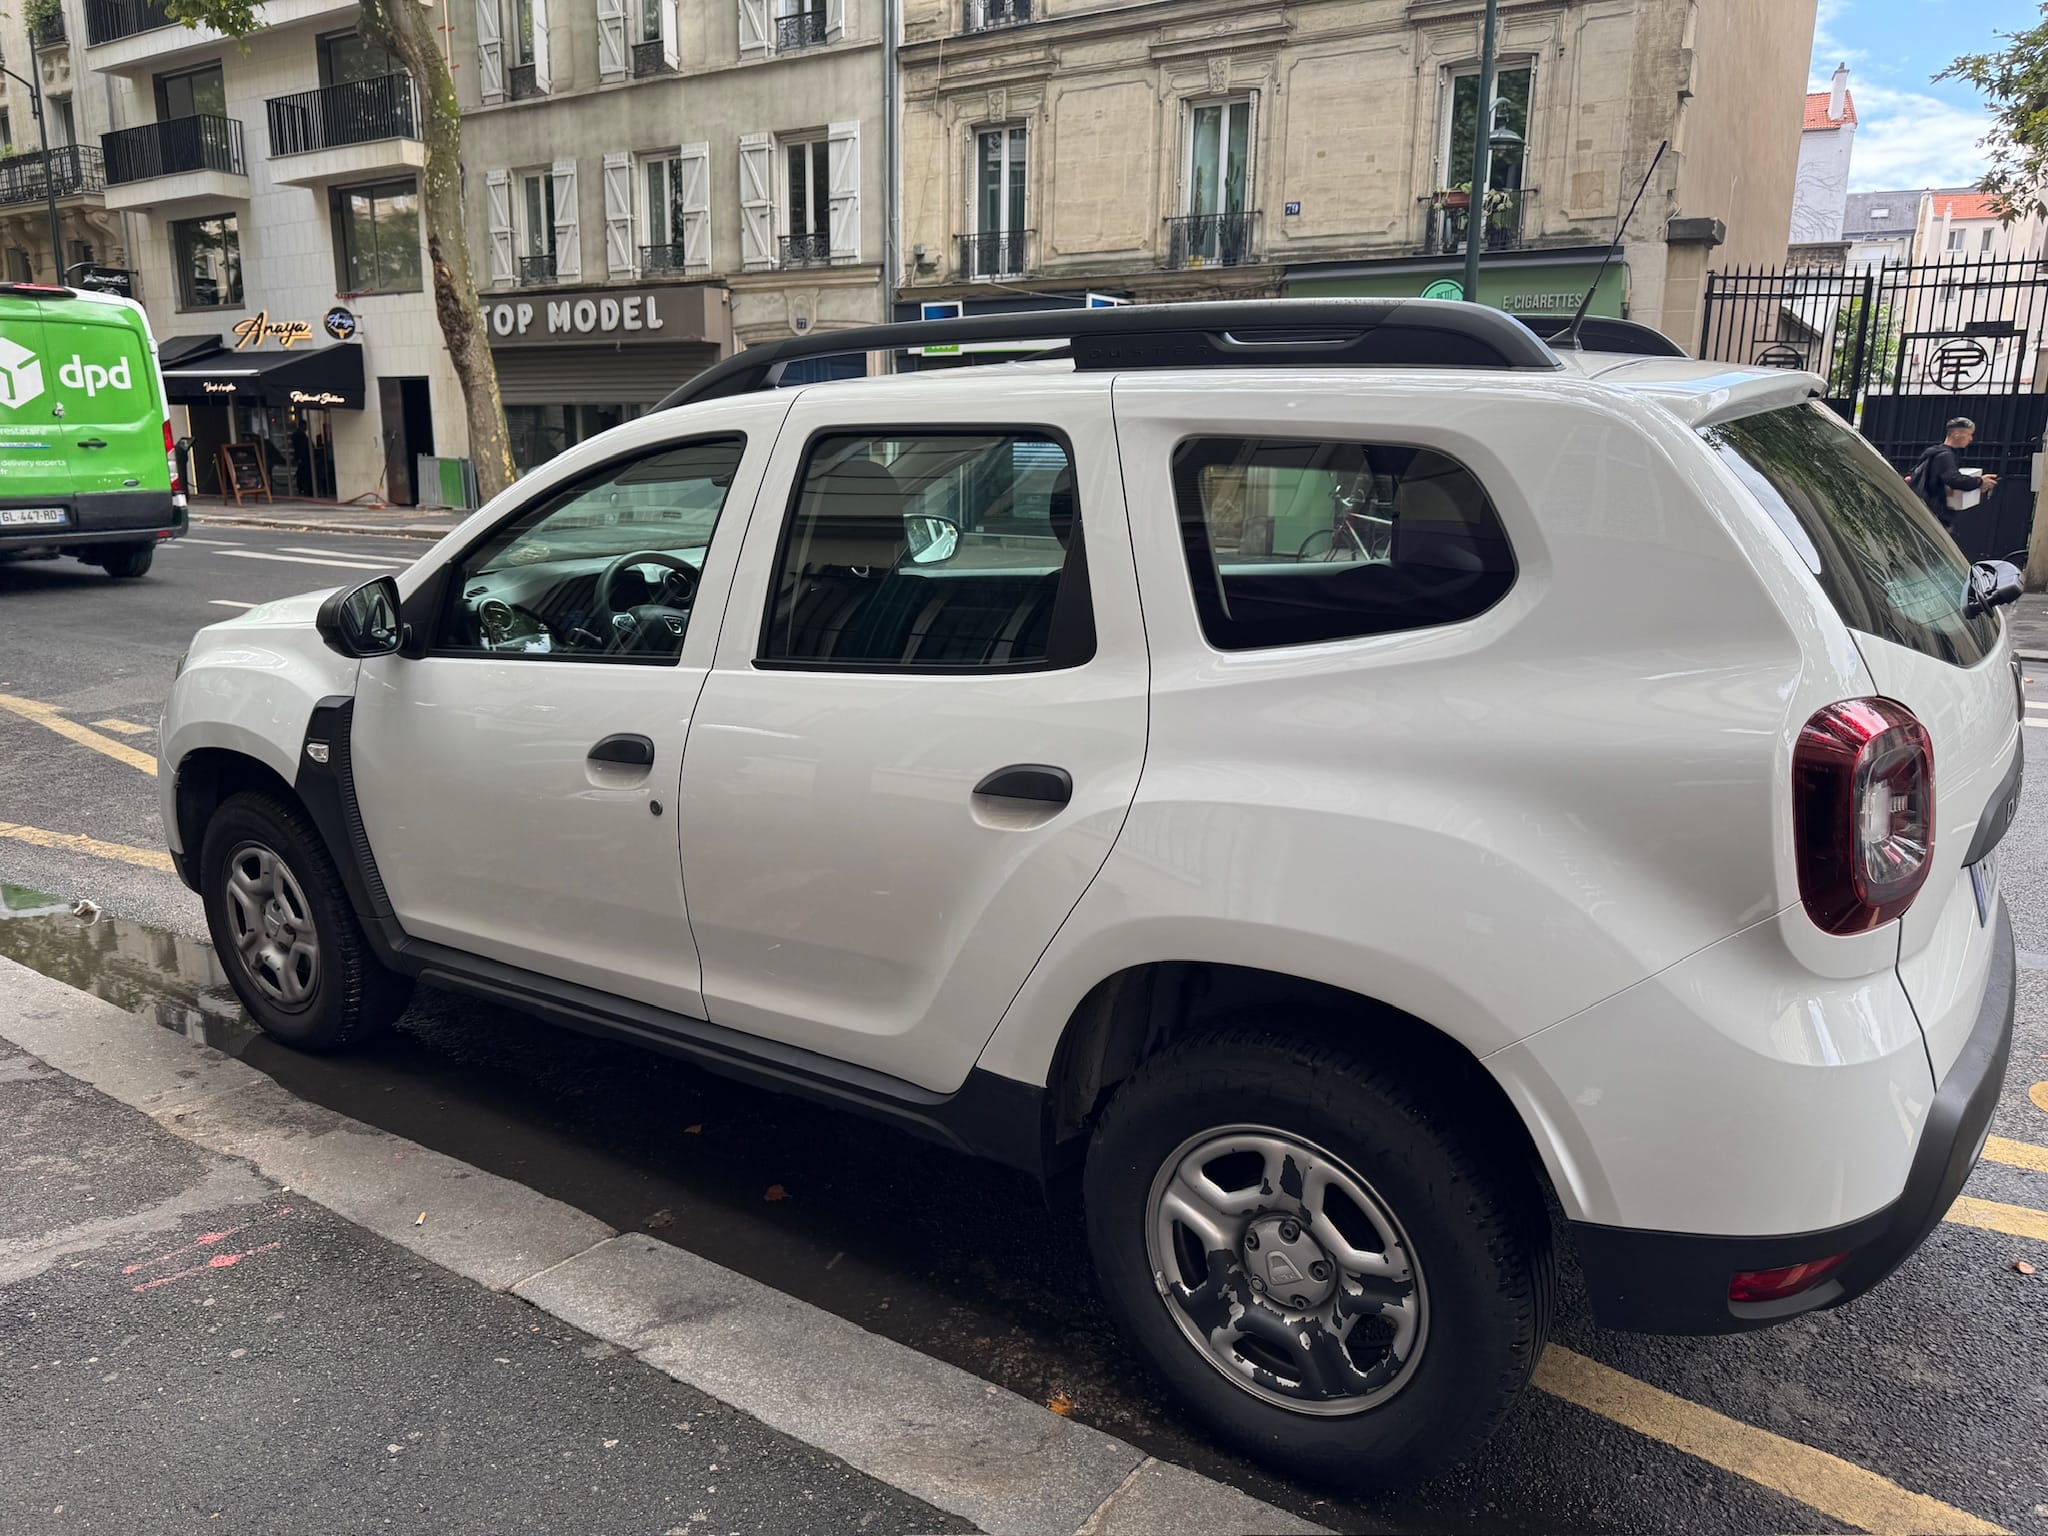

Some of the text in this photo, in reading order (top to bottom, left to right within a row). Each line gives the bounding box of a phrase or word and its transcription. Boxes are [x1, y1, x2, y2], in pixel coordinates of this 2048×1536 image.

[480, 295, 664, 336] TOP MODEL
[1503, 293, 1582, 309] E-CIGARETTES
[232, 310, 312, 348] Anaya
[59, 354, 132, 397] dpd
